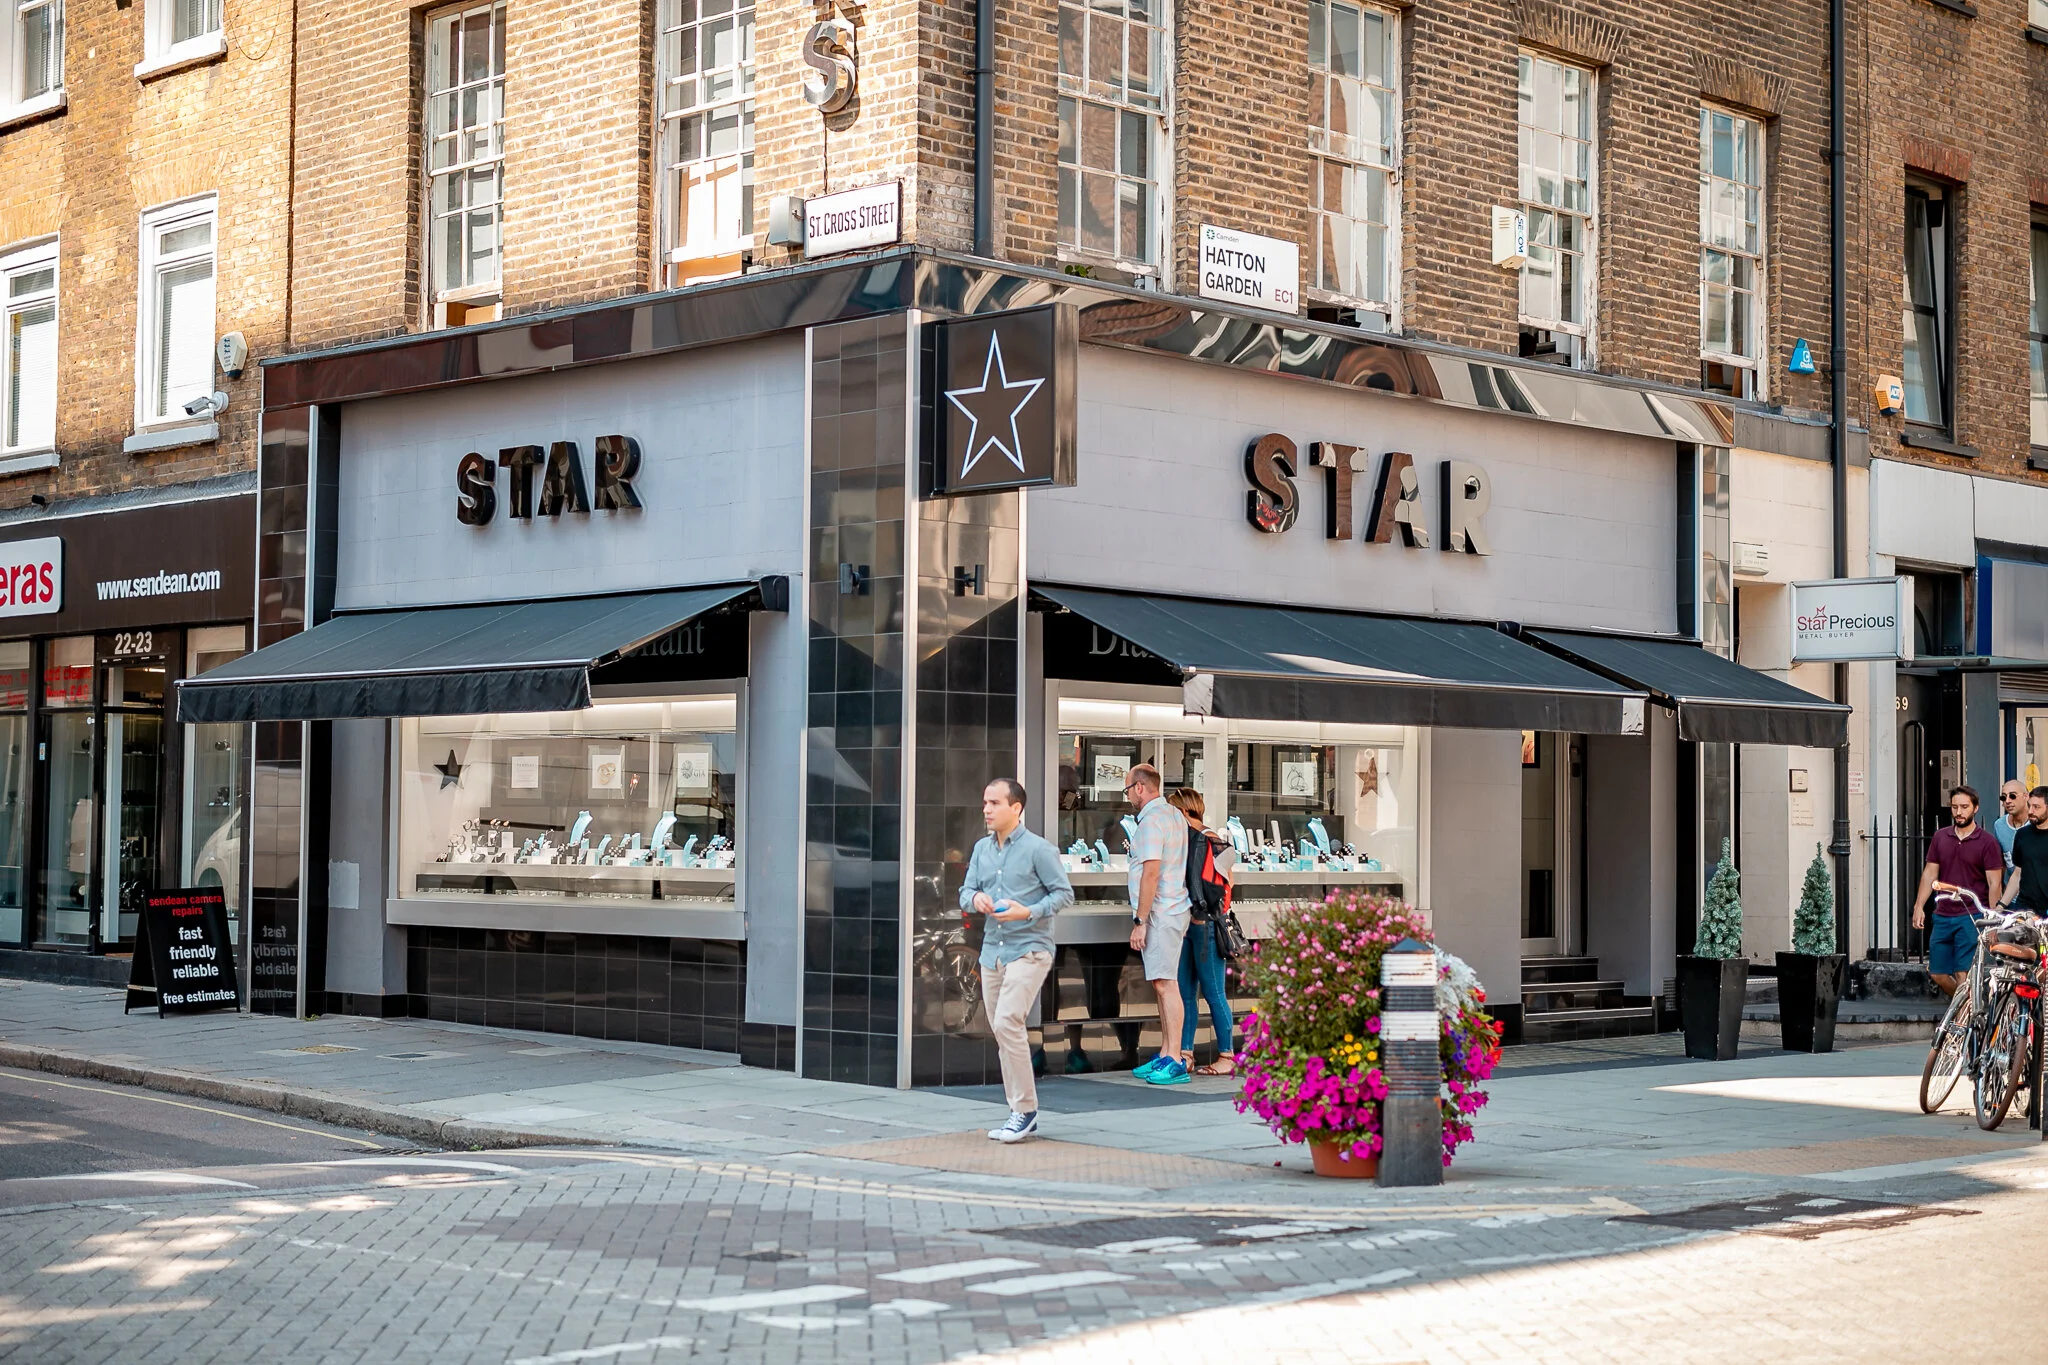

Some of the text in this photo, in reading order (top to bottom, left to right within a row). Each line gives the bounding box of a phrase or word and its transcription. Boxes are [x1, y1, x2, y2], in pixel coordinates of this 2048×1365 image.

[803, 0, 857, 113] S
[809, 202, 895, 239] ST. CROSS STREET
[1216, 232, 1240, 244] Camden
[1206, 245, 1266, 274] HATTON
[1205, 271, 1263, 299] GARDEN
[1275, 288, 1294, 305] EC1
[456, 434, 643, 526] STAR
[1246, 432, 1494, 556] STAR
[96, 569, 221, 601] www.sendean.com
[1797, 613, 1895, 631] Star Precious
[114, 631, 153, 655] 22-23
[1828, 631, 1854, 639] BUYER
[149, 894, 223, 907] sendean camera
[172, 906, 203, 918] repairs
[178, 926, 203, 940] fast
[169, 945, 217, 961] friendly
[173, 963, 219, 979] reliable
[163, 988, 236, 1005] free estimates
